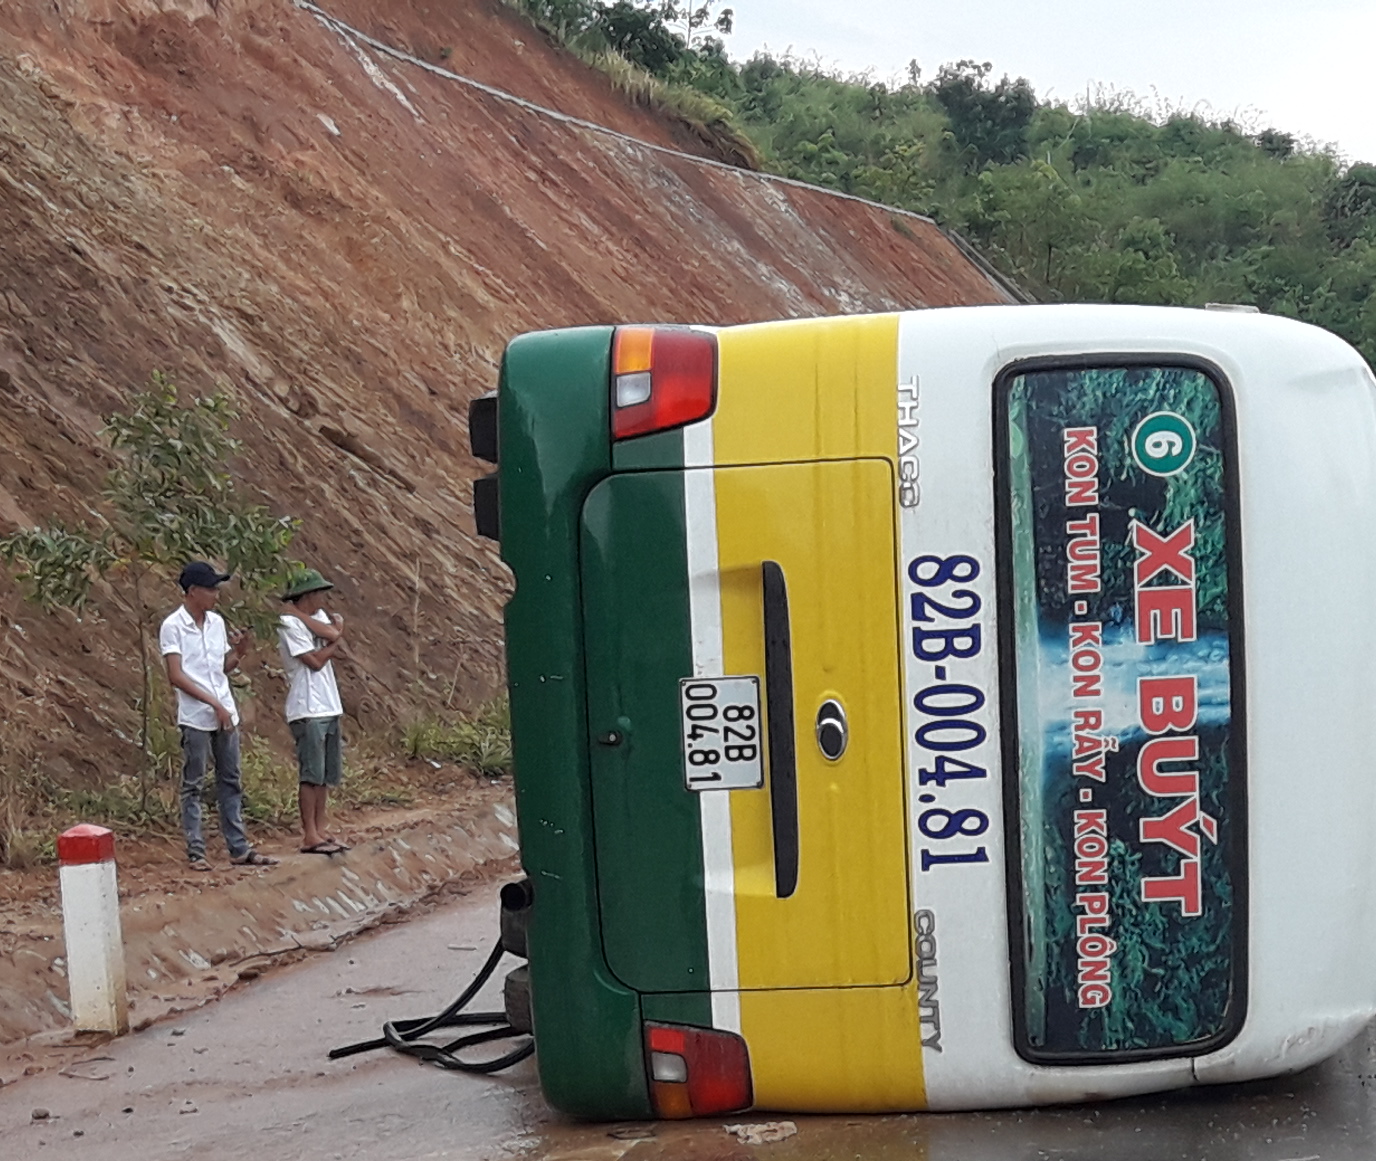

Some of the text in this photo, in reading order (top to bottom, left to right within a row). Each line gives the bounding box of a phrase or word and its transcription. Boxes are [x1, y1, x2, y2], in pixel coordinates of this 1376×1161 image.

[897, 375, 921, 509] THACO
[1064, 426, 1099, 506] KON
[1144, 430, 1183, 458] 6
[1066, 513, 1101, 593] TUM
[1069, 621, 1102, 698] KON
[685, 684, 722, 783] 004.81
[723, 705, 757, 762] 82B
[908, 554, 990, 871] 82B-004.81
[1133, 517, 1218, 918] XE BUÝT
[1074, 809, 1108, 884] KON
[913, 909, 943, 1053] COUNTY
[1076, 893, 1117, 1008] PLÔNG
